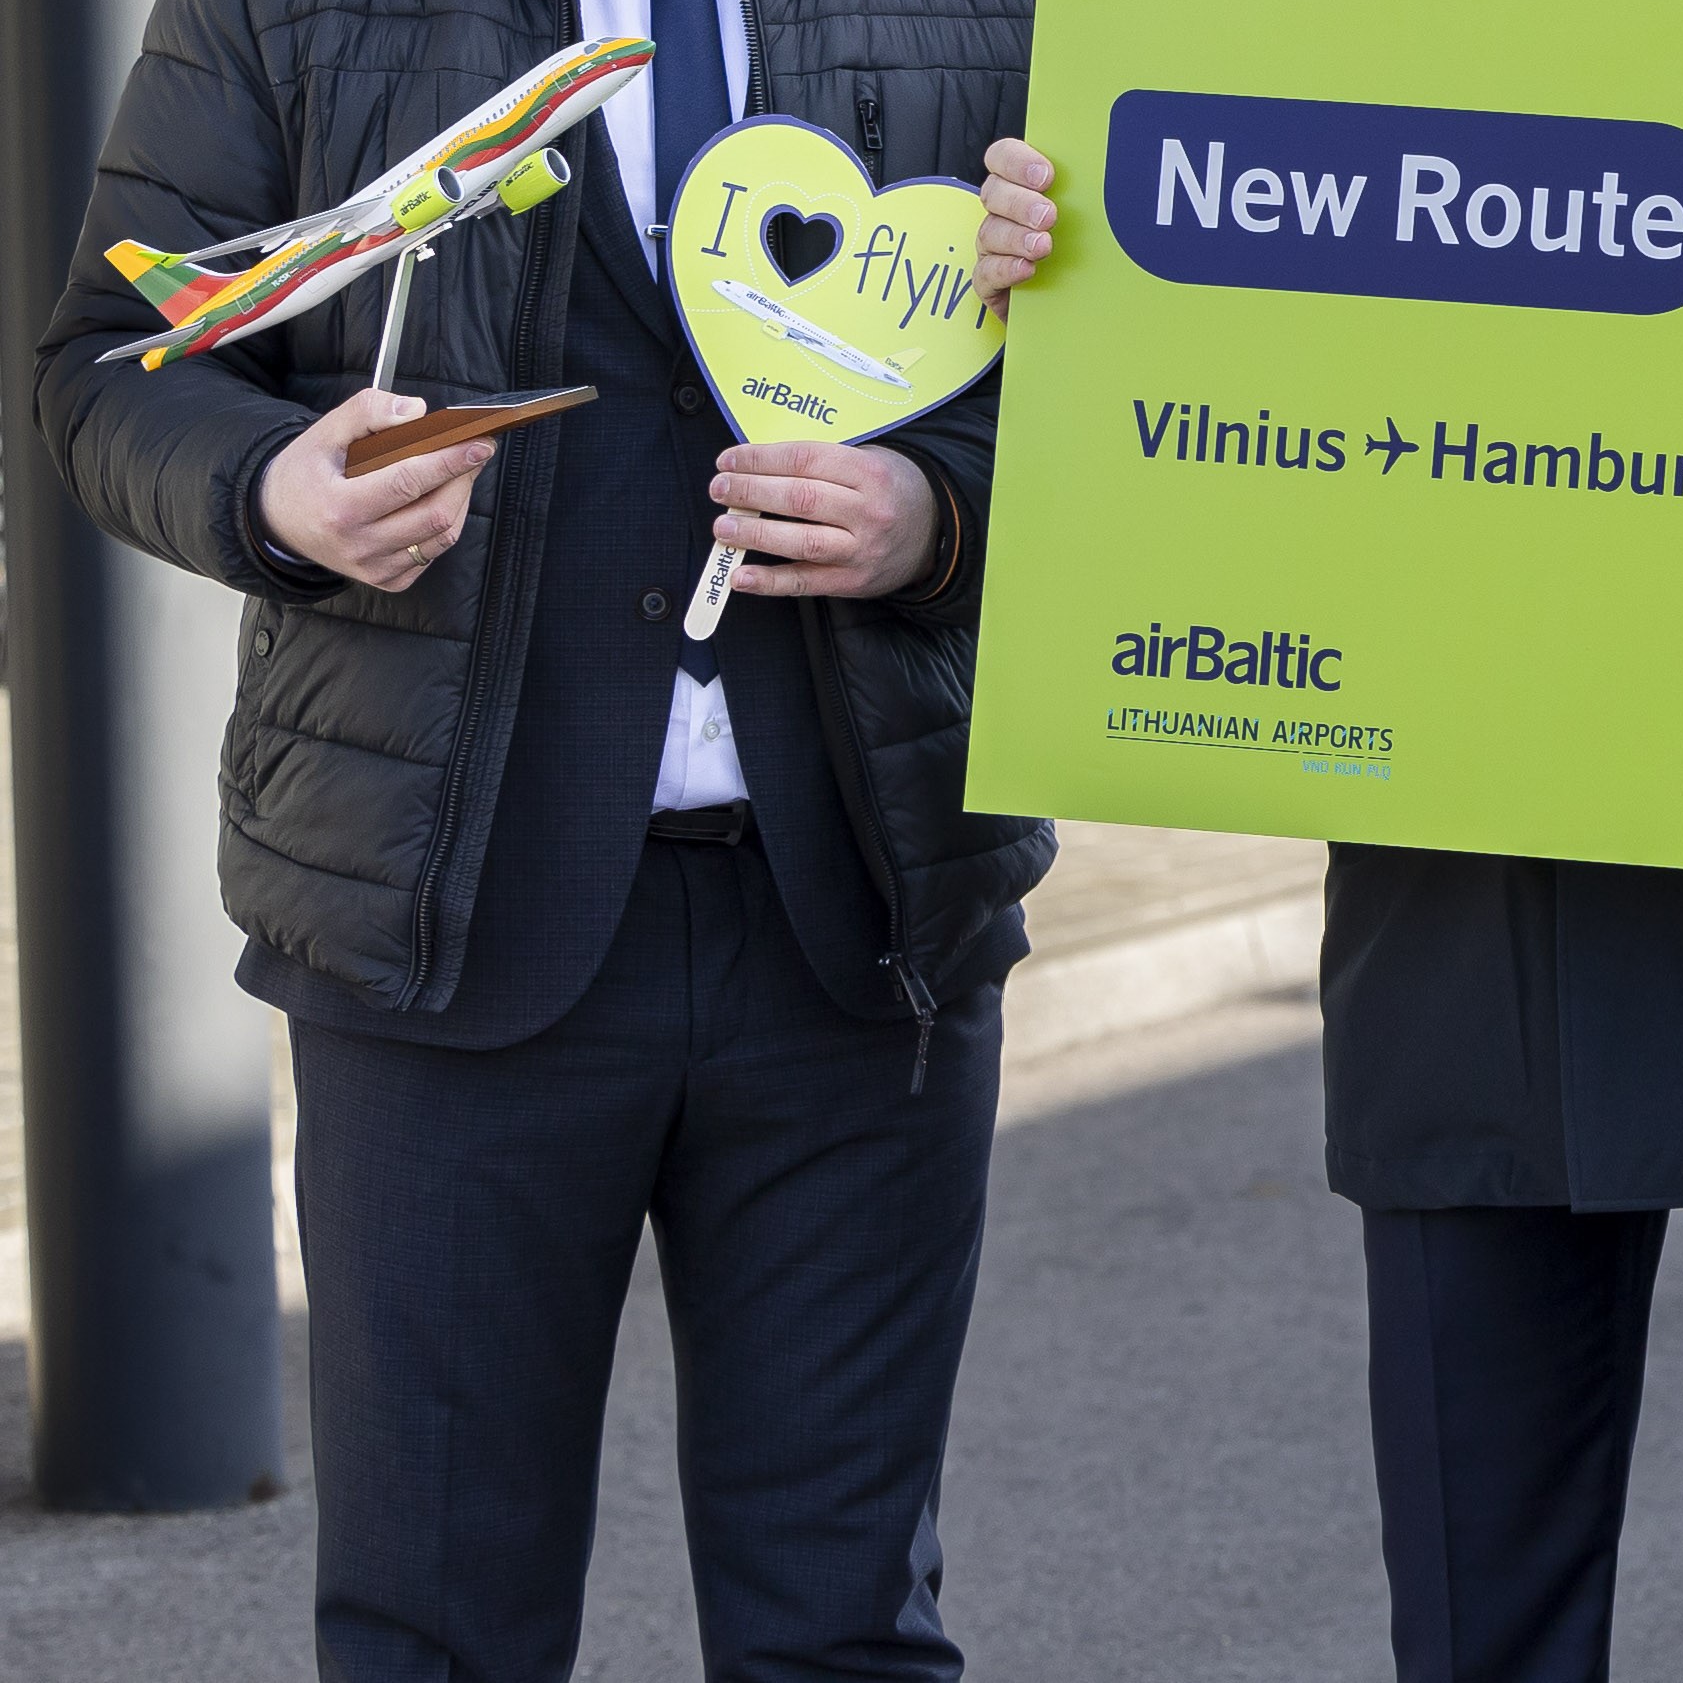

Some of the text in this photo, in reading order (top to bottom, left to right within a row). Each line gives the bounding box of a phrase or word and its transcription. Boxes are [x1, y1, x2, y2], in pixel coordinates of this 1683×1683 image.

[1155, 138, 1366, 237] New
[701, 182, 988, 330] I flyin
[746, 290, 785, 318] airBaltic
[742, 377, 838, 425] airBaltic
[1133, 400, 1346, 472] Vilnius
[706, 546, 737, 606] airBaltic
[1112, 623, 1341, 692] airBaltic
[1107, 708, 1393, 751] LITHUANIAN AIRPORTS
